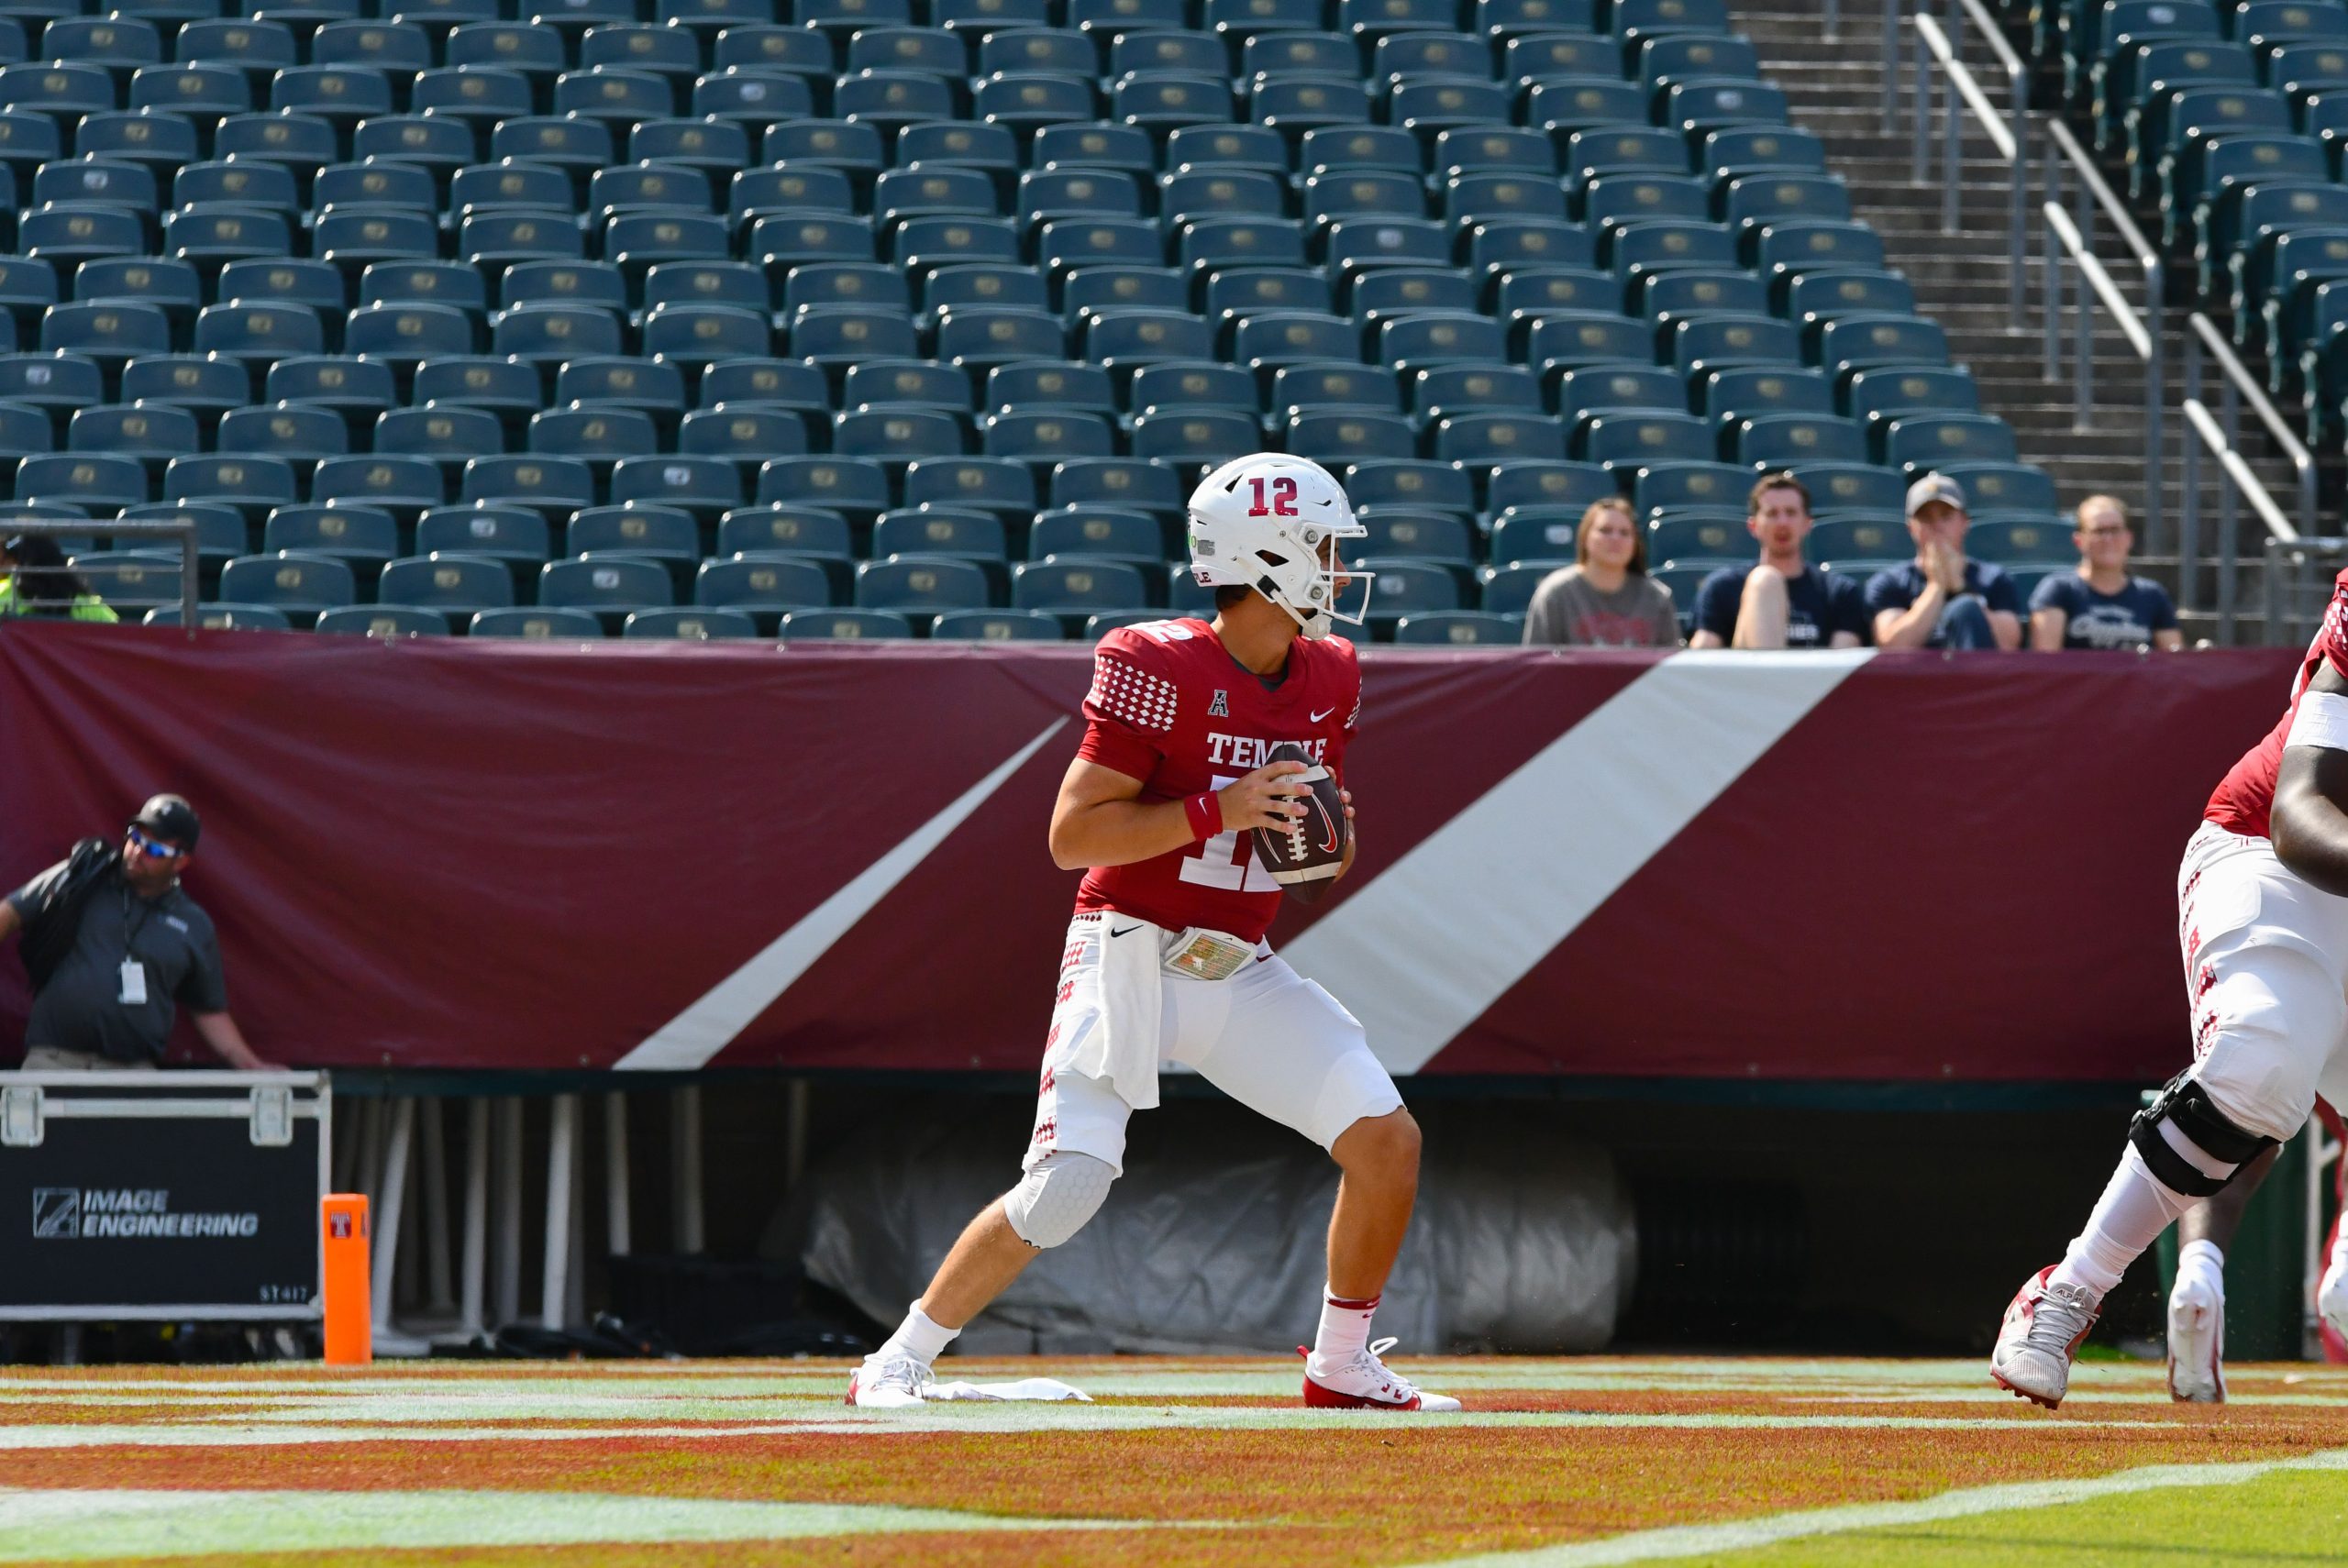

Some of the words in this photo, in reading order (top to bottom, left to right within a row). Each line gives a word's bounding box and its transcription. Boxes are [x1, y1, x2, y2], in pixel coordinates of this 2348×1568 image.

[1248, 478, 1299, 516] 12
[84, 1189, 169, 1212] IMAGE
[83, 1213, 259, 1237] ENGINEERING
